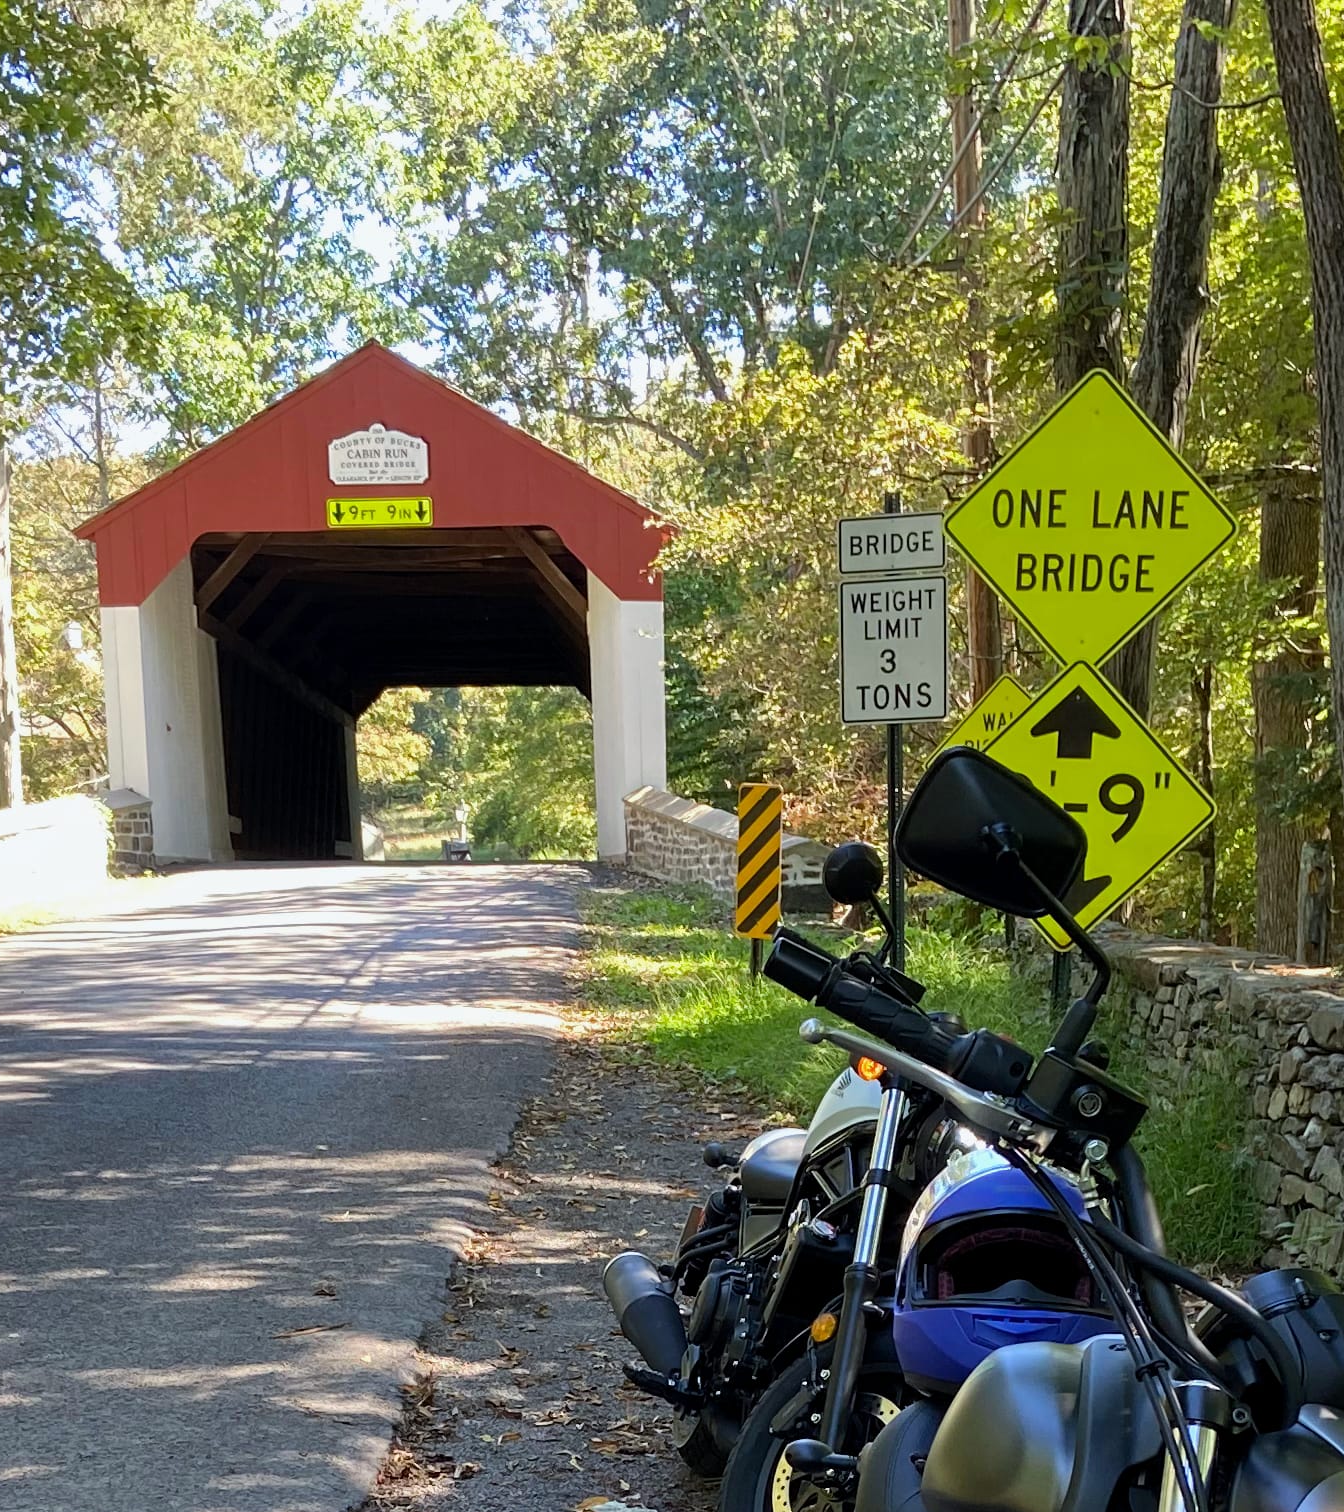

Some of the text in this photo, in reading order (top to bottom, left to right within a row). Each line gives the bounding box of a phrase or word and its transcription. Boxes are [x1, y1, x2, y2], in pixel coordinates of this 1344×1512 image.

[341, 461, 380, 469] COVERED
[347, 449, 408, 459] CABIN RUN
[992, 488, 1190, 530] ONE LANE
[849, 530, 935, 556] BRIDGE
[1015, 553, 1155, 593] BRIDGE
[851, 589, 936, 614] WEIGHT
[864, 617, 922, 640] LIMIT
[880, 649, 896, 674] 3
[856, 682, 932, 710] TONS
